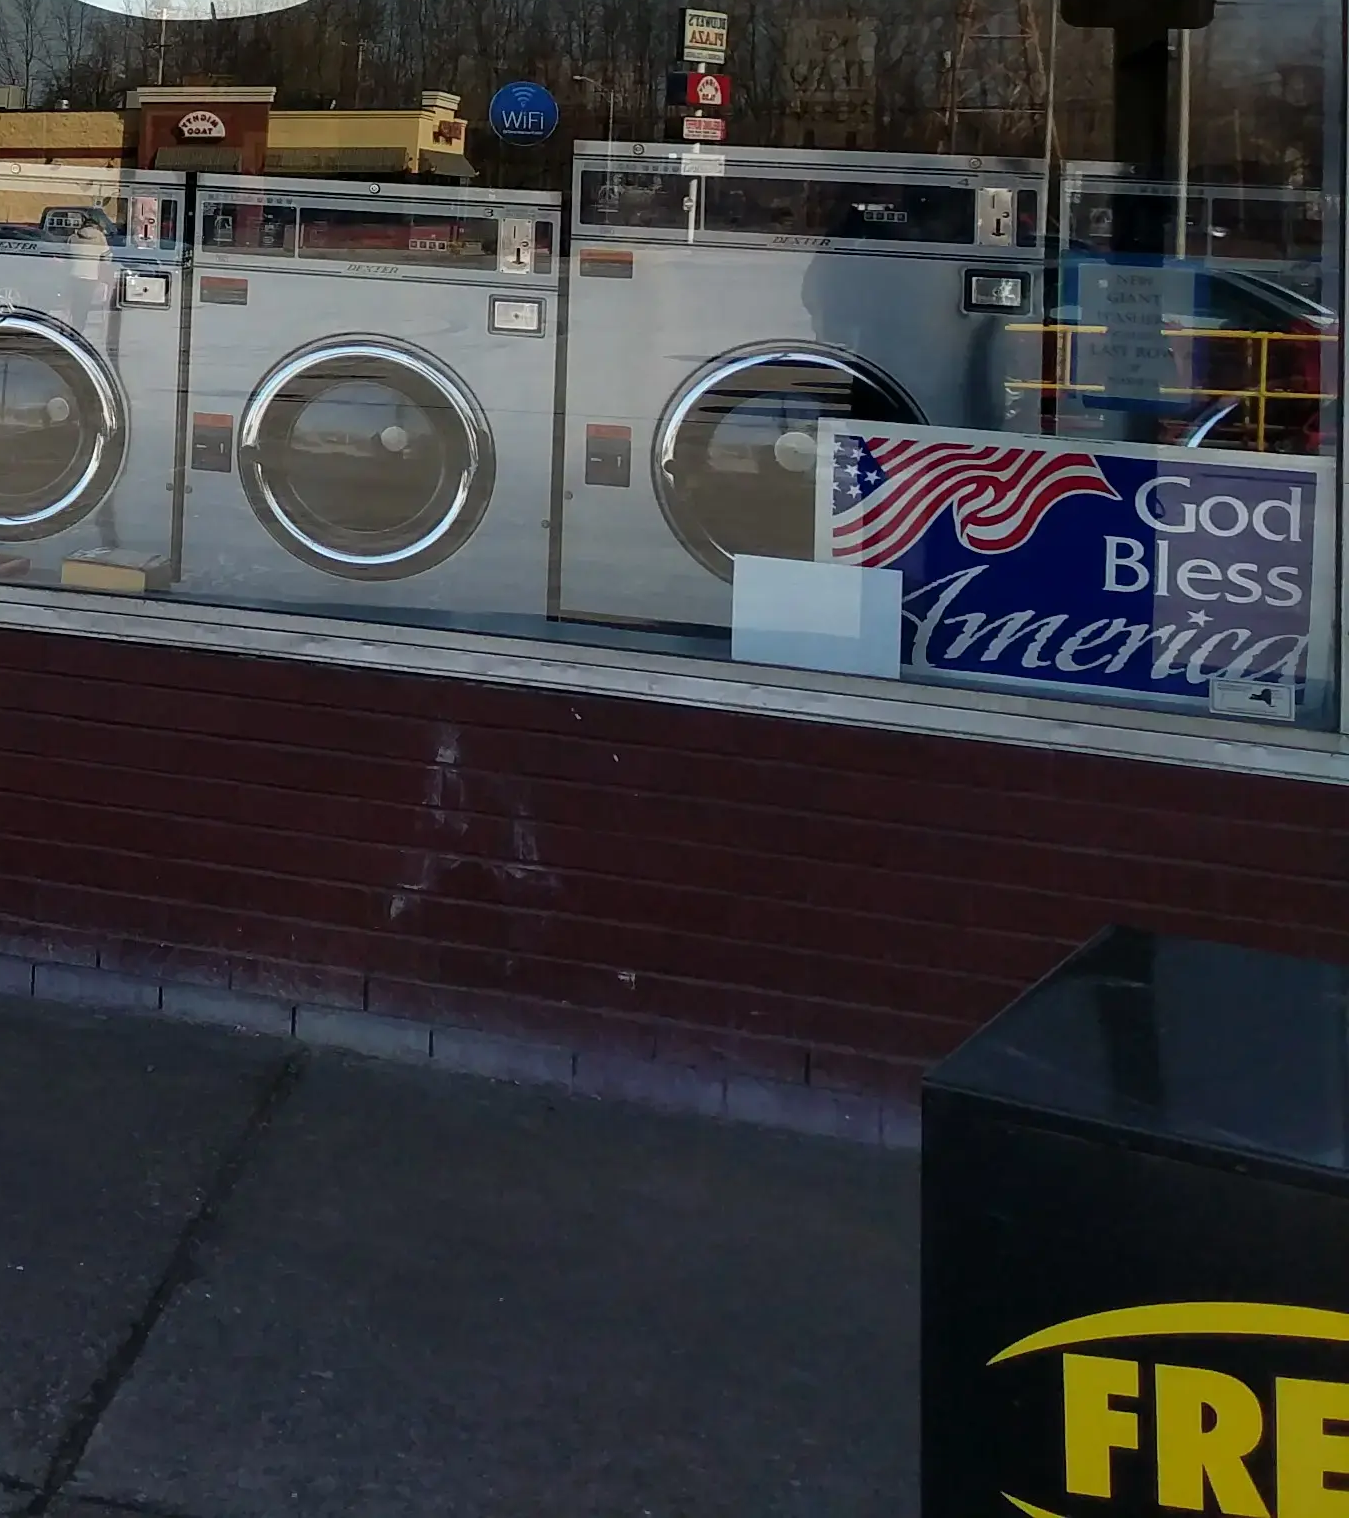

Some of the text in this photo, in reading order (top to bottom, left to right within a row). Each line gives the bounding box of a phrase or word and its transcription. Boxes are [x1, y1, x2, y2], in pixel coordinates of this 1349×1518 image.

[501, 109, 544, 130] WiFi
[1135, 476, 1302, 542] God
[1103, 535, 1304, 607] Bless
[902, 564, 1310, 689] America
